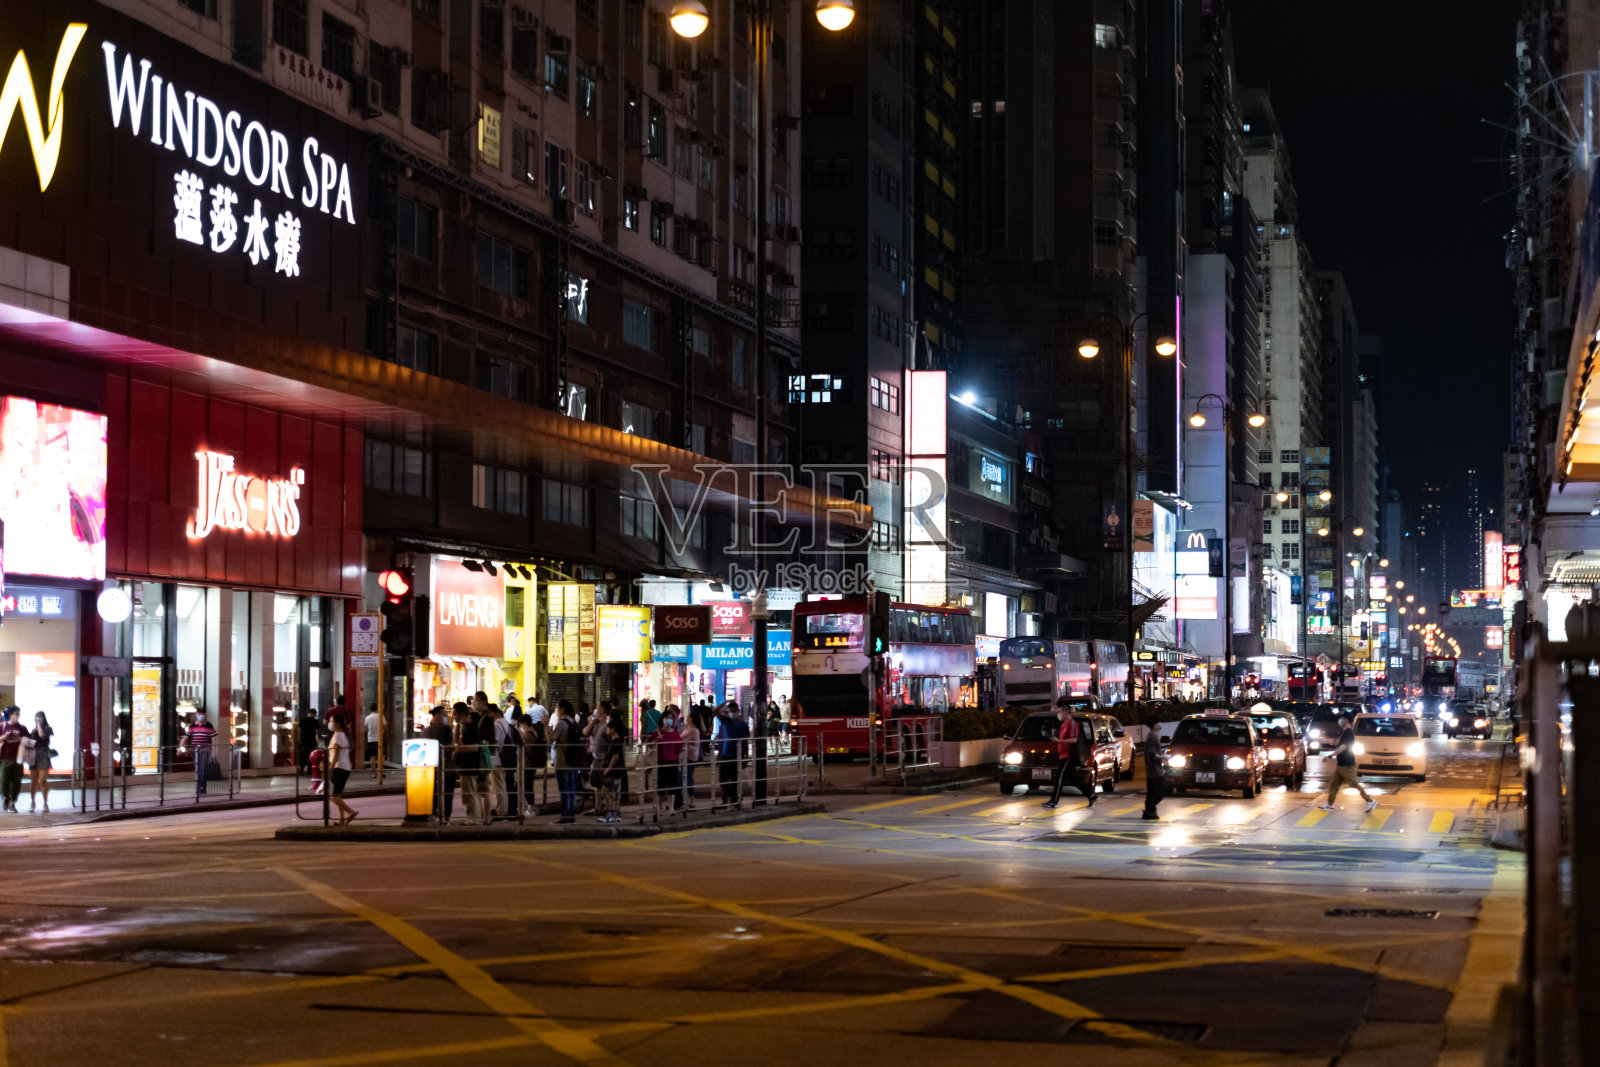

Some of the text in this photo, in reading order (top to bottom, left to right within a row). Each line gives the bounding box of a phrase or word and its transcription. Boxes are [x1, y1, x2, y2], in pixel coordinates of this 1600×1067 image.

[102, 40, 356, 225] WINDSOR SPA
[712, 604, 744, 618] Sasa
[664, 615, 699, 629] Sasa
[767, 640, 791, 652] LAN
[705, 647, 754, 659] MILANO
[846, 717, 871, 729] KMB
